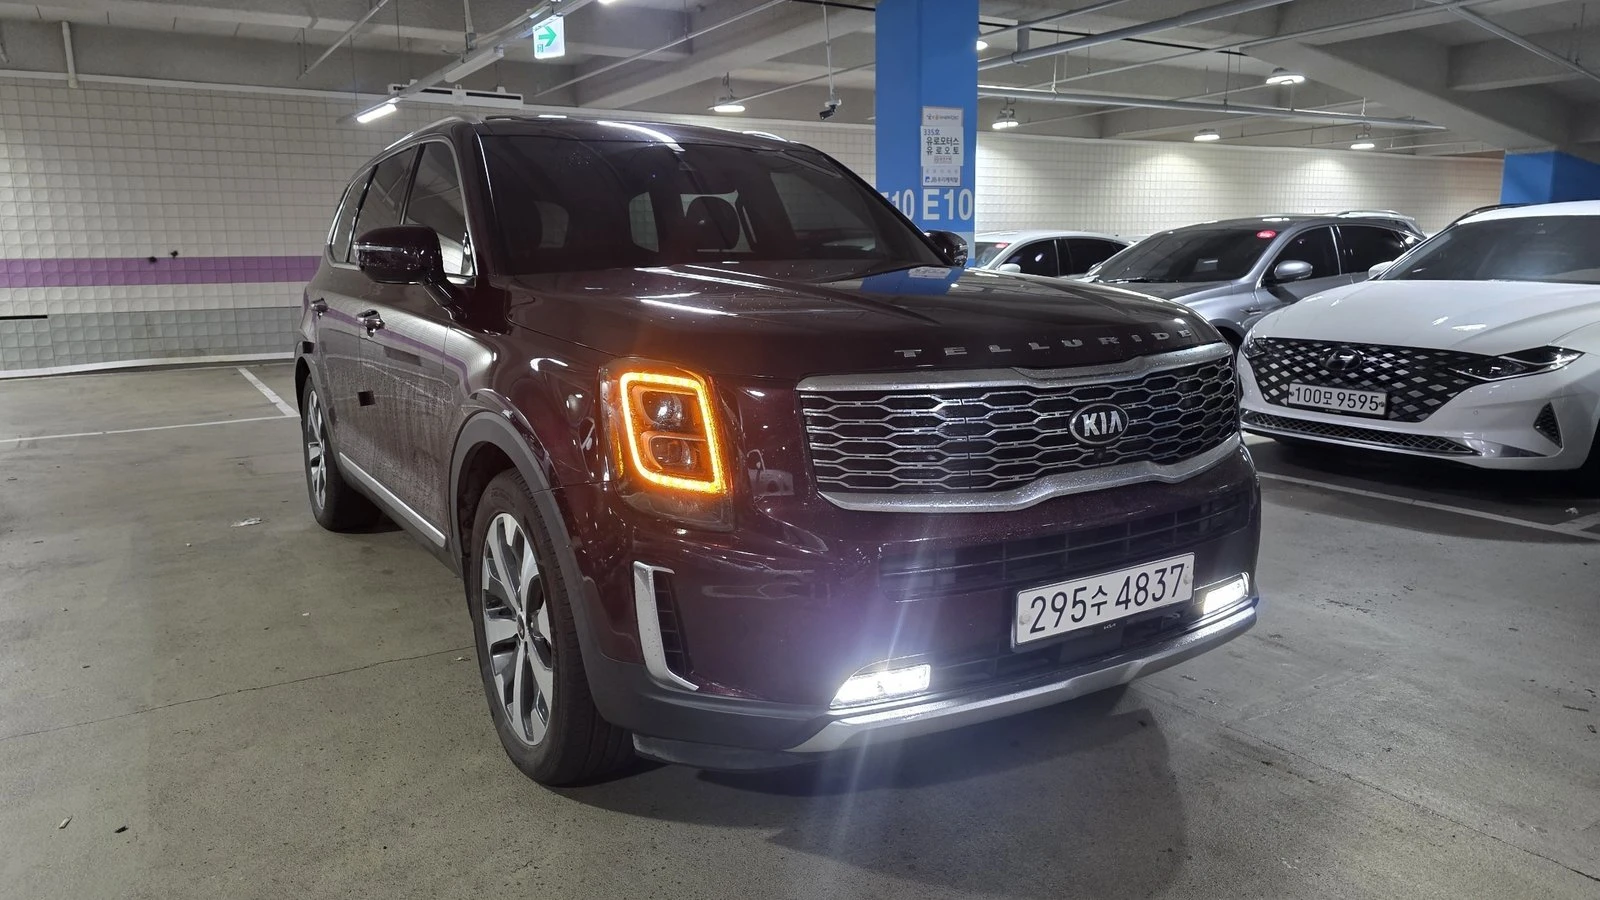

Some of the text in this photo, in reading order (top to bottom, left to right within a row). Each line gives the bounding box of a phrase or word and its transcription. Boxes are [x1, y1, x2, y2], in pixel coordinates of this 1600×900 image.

[923, 128, 940, 136] 335호
[926, 136, 960, 147] 유로모터스
[880, 188, 915, 221] 10
[922, 188, 973, 220] E10
[894, 329, 1193, 358] TELLURIDE
[1081, 410, 1123, 437] KIA
